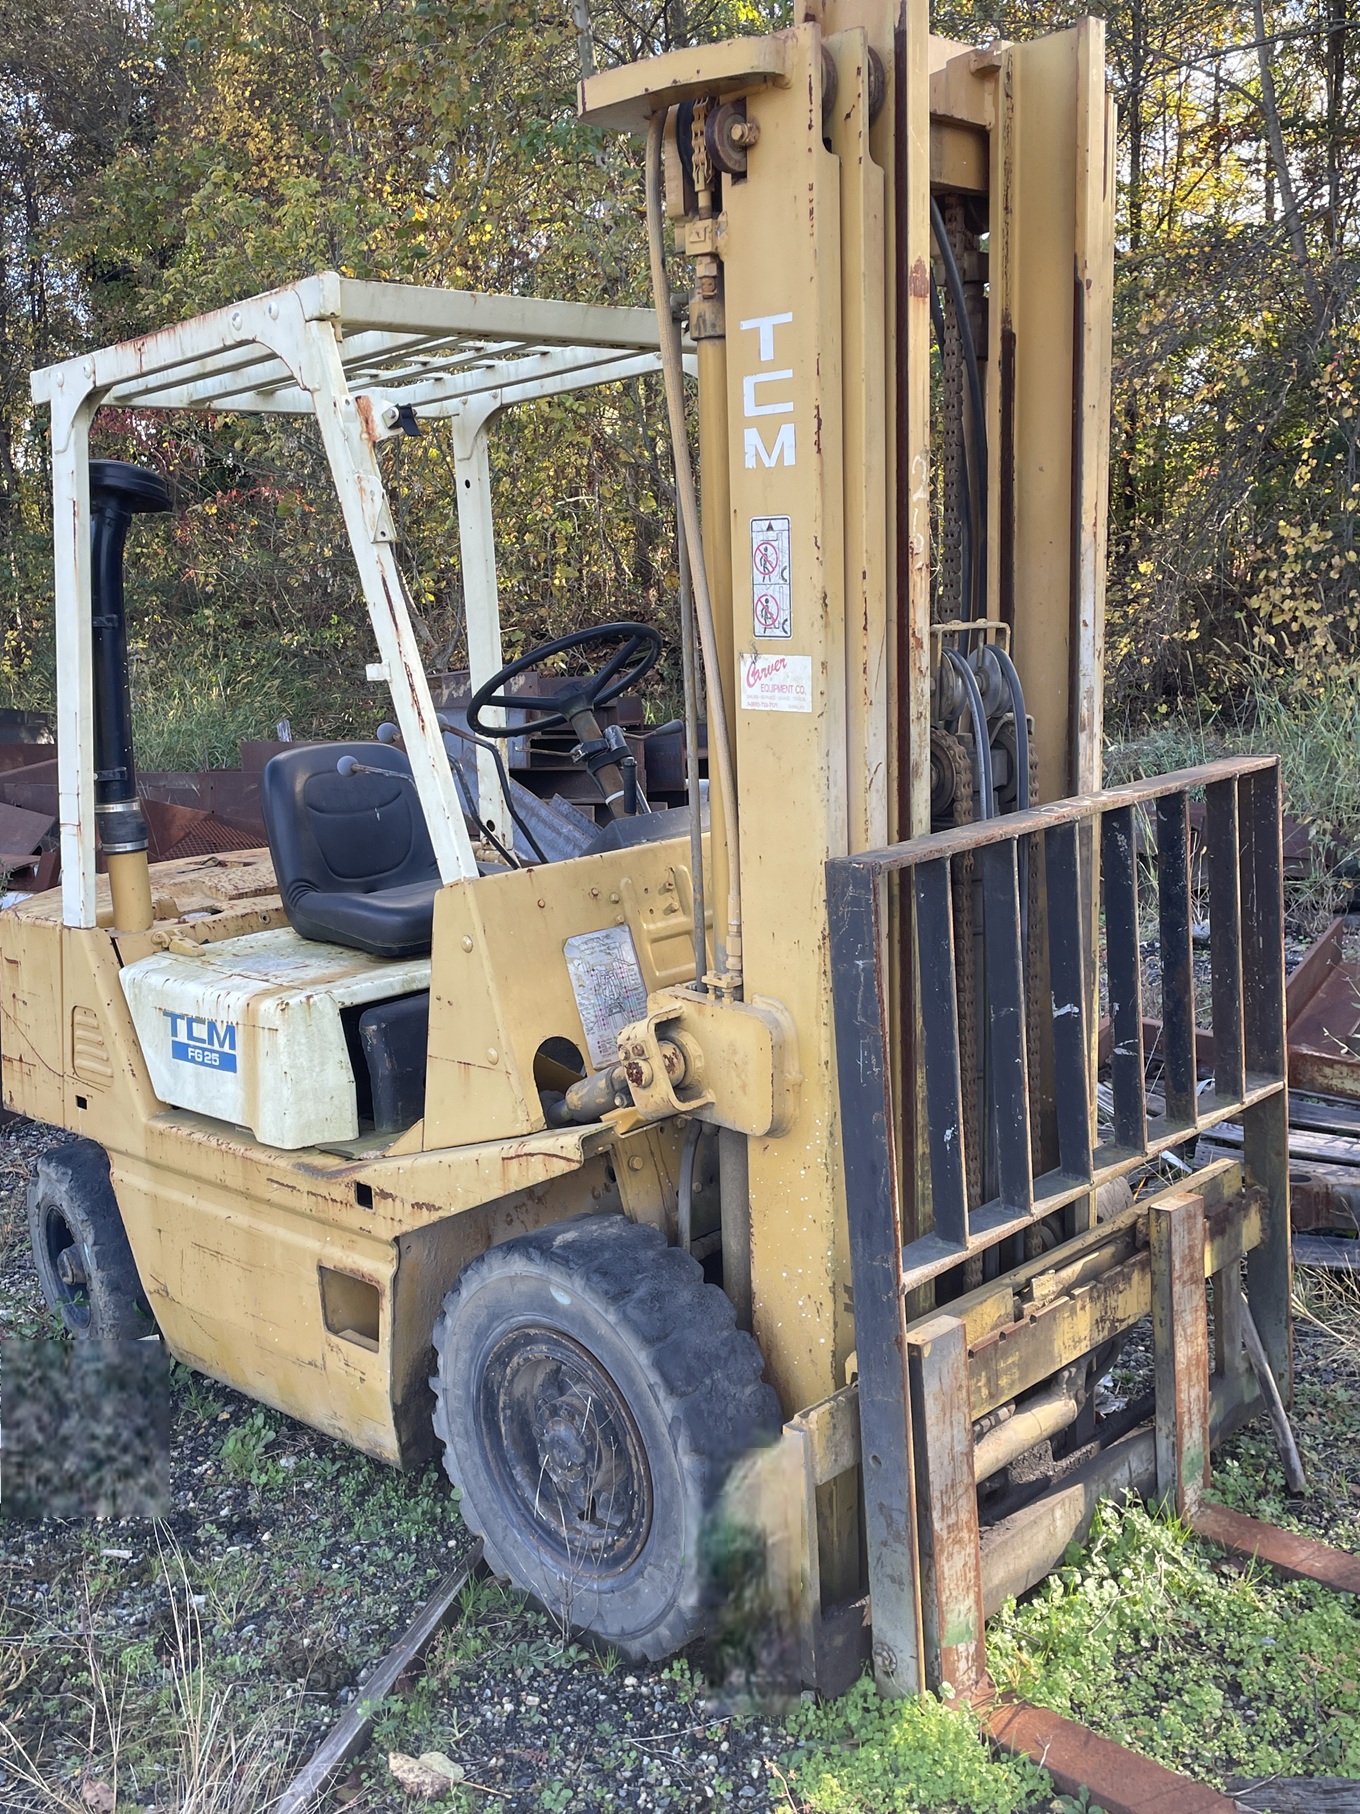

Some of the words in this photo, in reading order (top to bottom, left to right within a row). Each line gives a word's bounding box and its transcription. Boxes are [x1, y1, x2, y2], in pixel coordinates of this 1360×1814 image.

[739, 312, 796, 469] TCM
[746, 657, 788, 688] Carver
[760, 683, 793, 694] EQUIPMENT
[162, 1010, 237, 1051] TCM
